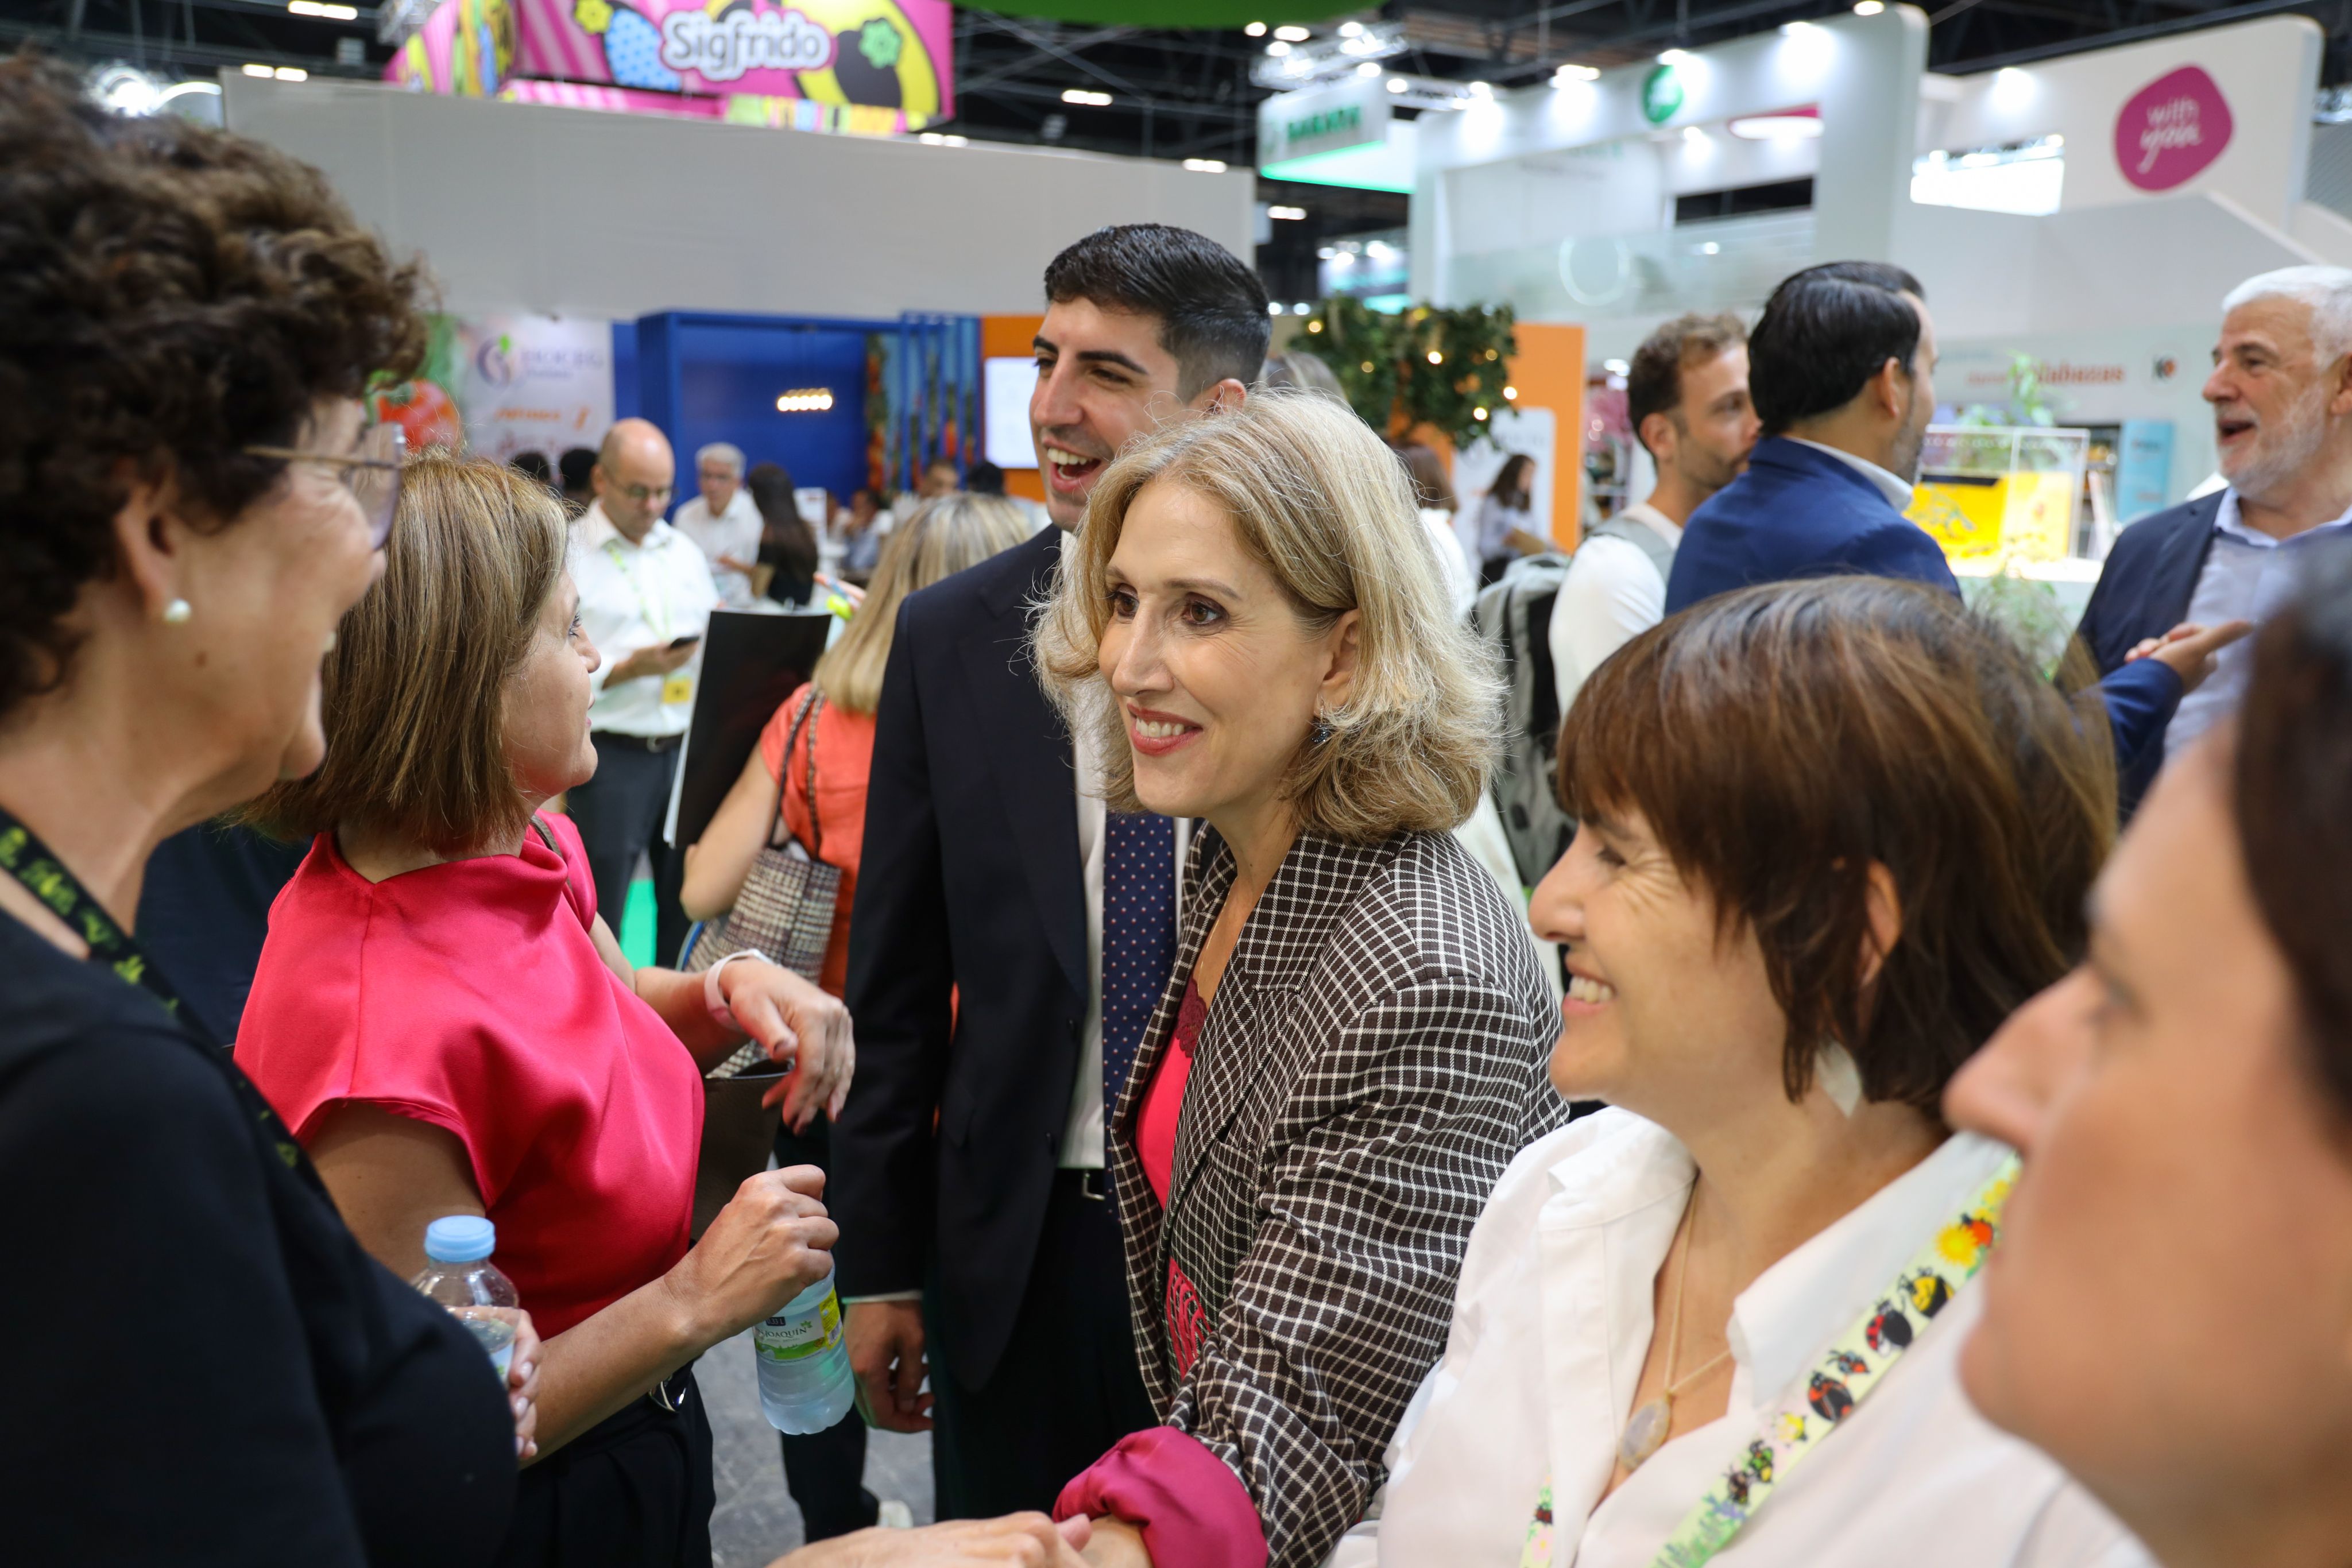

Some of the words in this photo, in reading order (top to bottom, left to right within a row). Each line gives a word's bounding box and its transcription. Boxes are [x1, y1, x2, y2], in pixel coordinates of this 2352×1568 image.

[670, 17, 824, 74] Sigfrido
[2146, 95, 2200, 127] with
[2136, 122, 2204, 175] you
